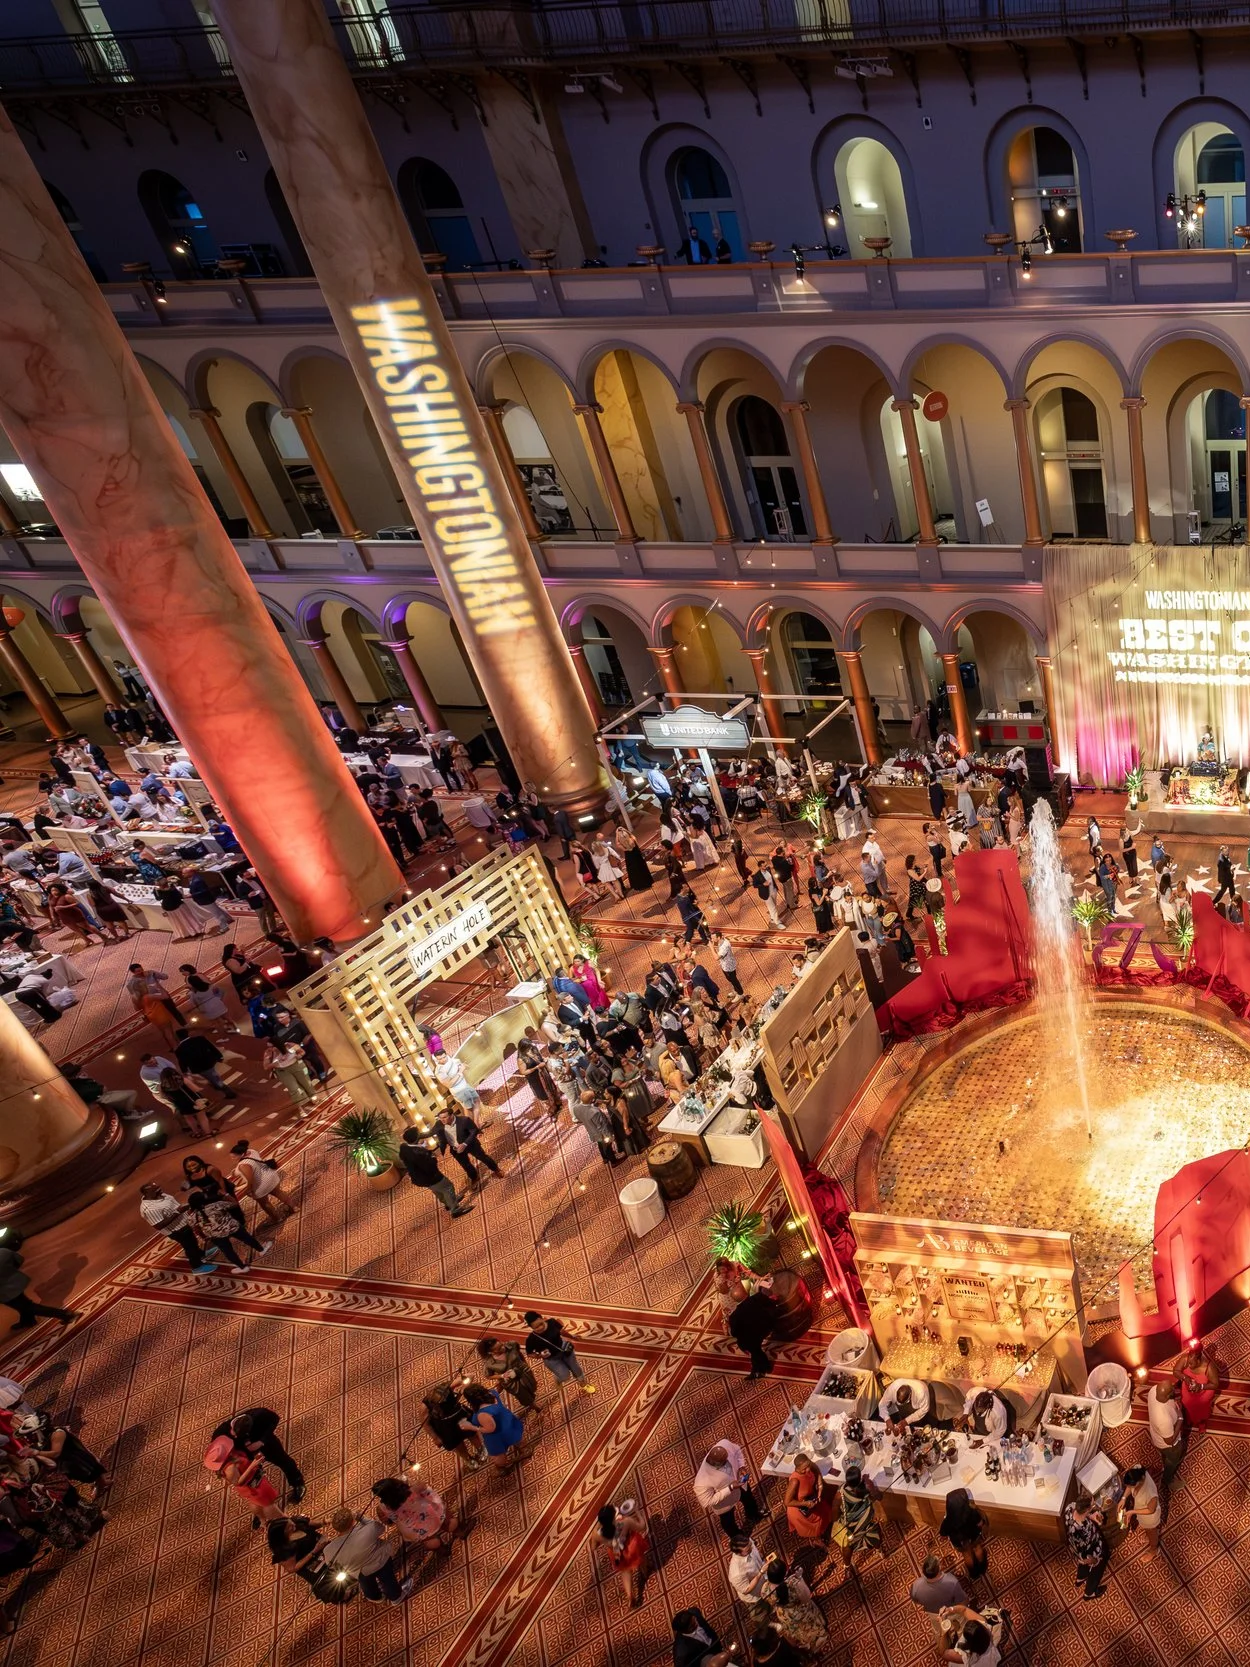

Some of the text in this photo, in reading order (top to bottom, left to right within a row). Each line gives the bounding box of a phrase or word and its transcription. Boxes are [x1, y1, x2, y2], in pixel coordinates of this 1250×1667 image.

[351, 299, 537, 635] WASHINGTONIAN
[1118, 618, 1221, 651] BEST
[670, 726, 729, 735] UNITED BANK
[463, 908, 486, 933] HOLE
[953, 1239, 1008, 1250] AMERICAN
[954, 1245, 1009, 1256] BEVERAGE
[944, 1277, 986, 1288] WANTED
